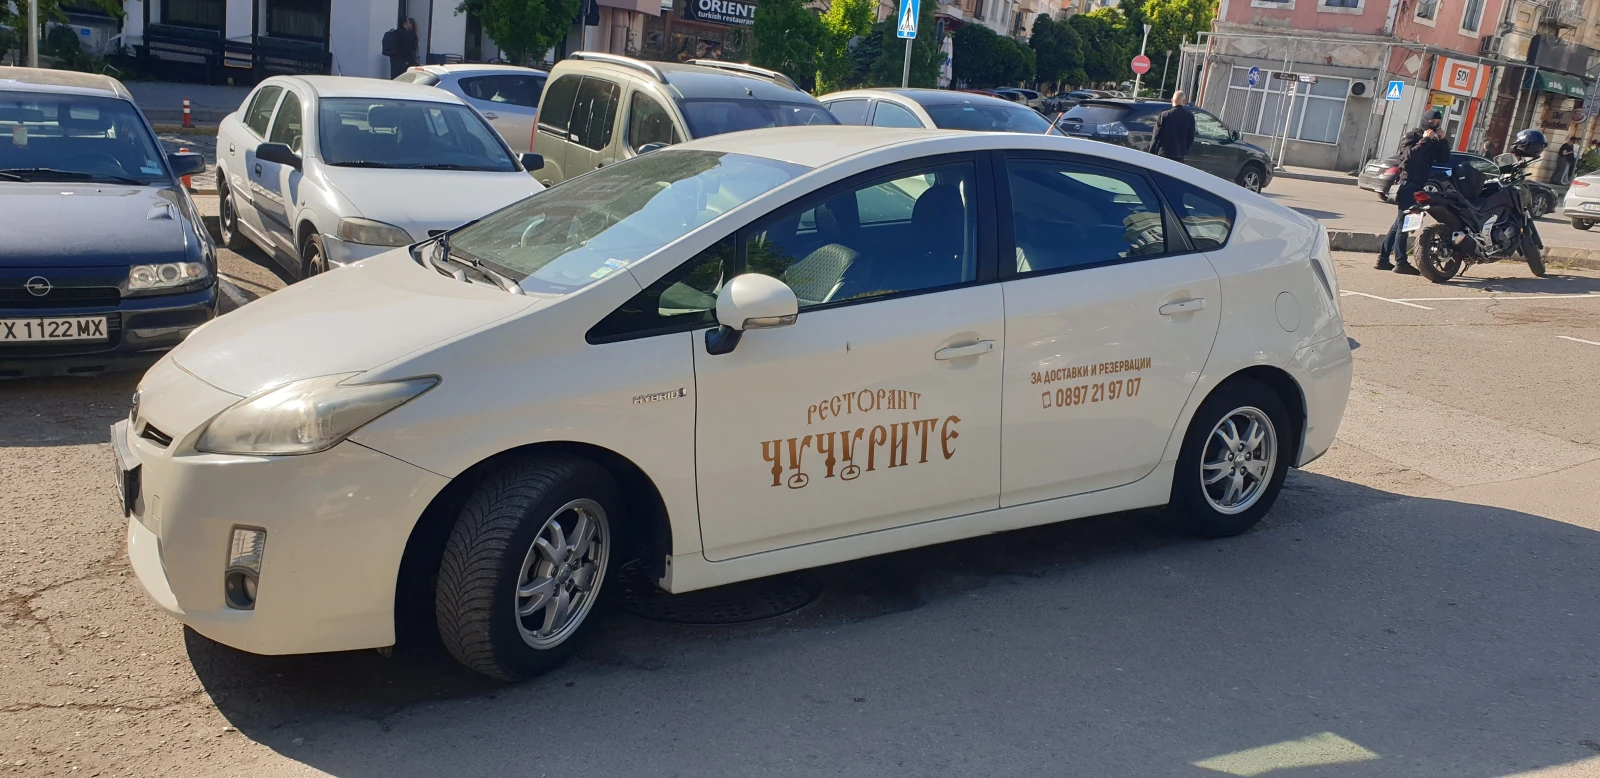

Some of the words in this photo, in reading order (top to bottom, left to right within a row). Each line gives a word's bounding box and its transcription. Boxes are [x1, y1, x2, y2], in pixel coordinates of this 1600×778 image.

[698, 0, 756, 18] ORIENT
[698, 11, 721, 21] turkish
[1456, 69, 1470, 83] SDI
[0, 321, 17, 340] X
[24, 320, 73, 339] 1122
[77, 319, 104, 337] MX
[1030, 371, 1042, 385] ЗА
[1043, 365, 1089, 384] ДОСТАВКИ
[1091, 363, 1097, 376] И
[1099, 357, 1152, 375] РЕЗЕРВАЦИИ
[632, 390, 680, 405] HYBRID
[1055, 384, 1089, 408] 0897
[1091, 382, 1105, 402] 21
[1108, 379, 1123, 400] 97
[1126, 377, 1142, 397] 07
[807, 388, 922, 425] РЕСТОРАНТ
